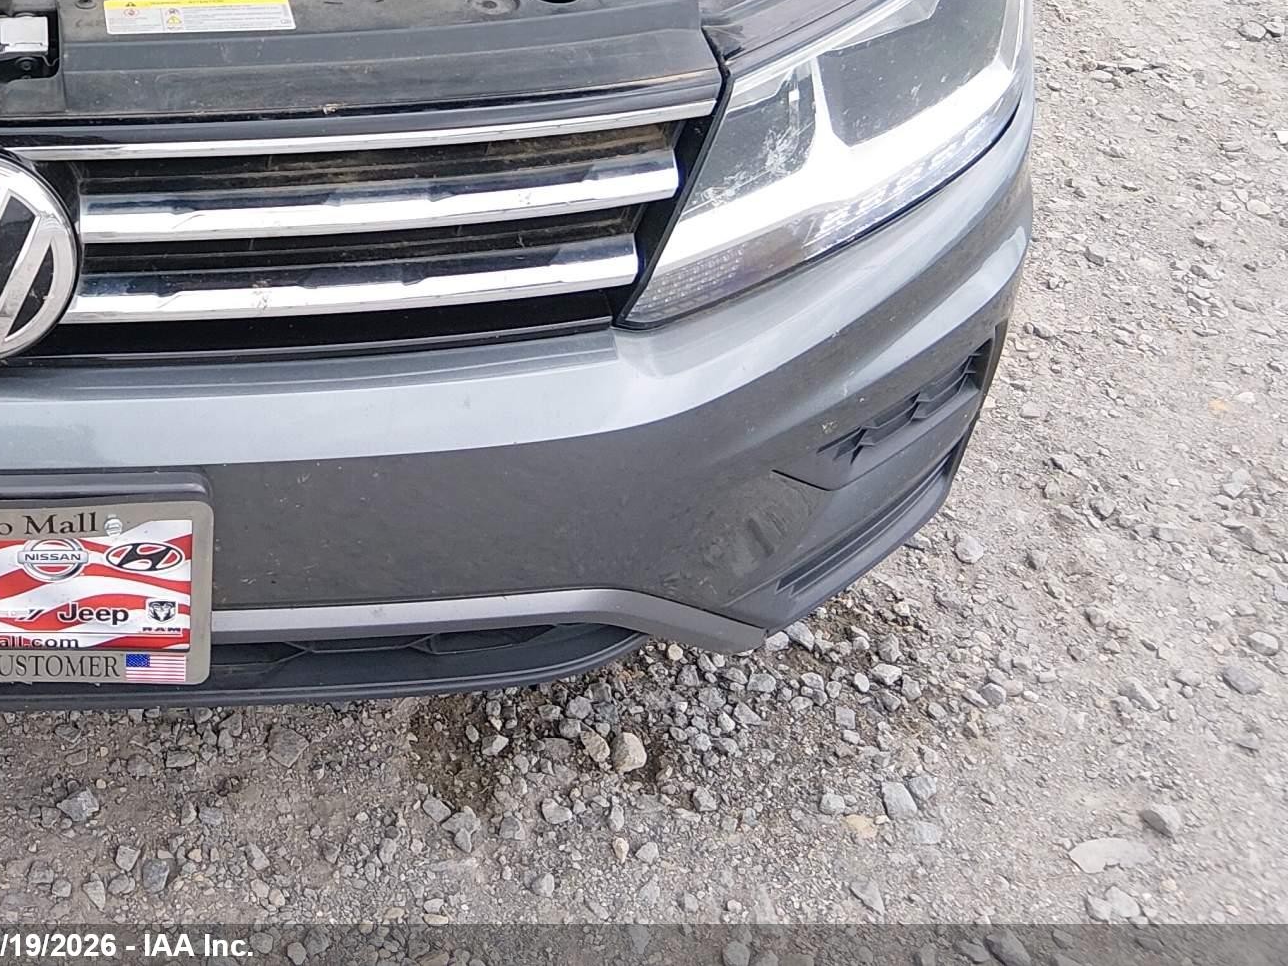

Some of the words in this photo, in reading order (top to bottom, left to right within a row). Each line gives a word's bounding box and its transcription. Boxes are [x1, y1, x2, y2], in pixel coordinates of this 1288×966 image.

[24, 512, 98, 534] Mall
[24, 553, 82, 562] NISSAN
[58, 604, 129, 625] Jeep
